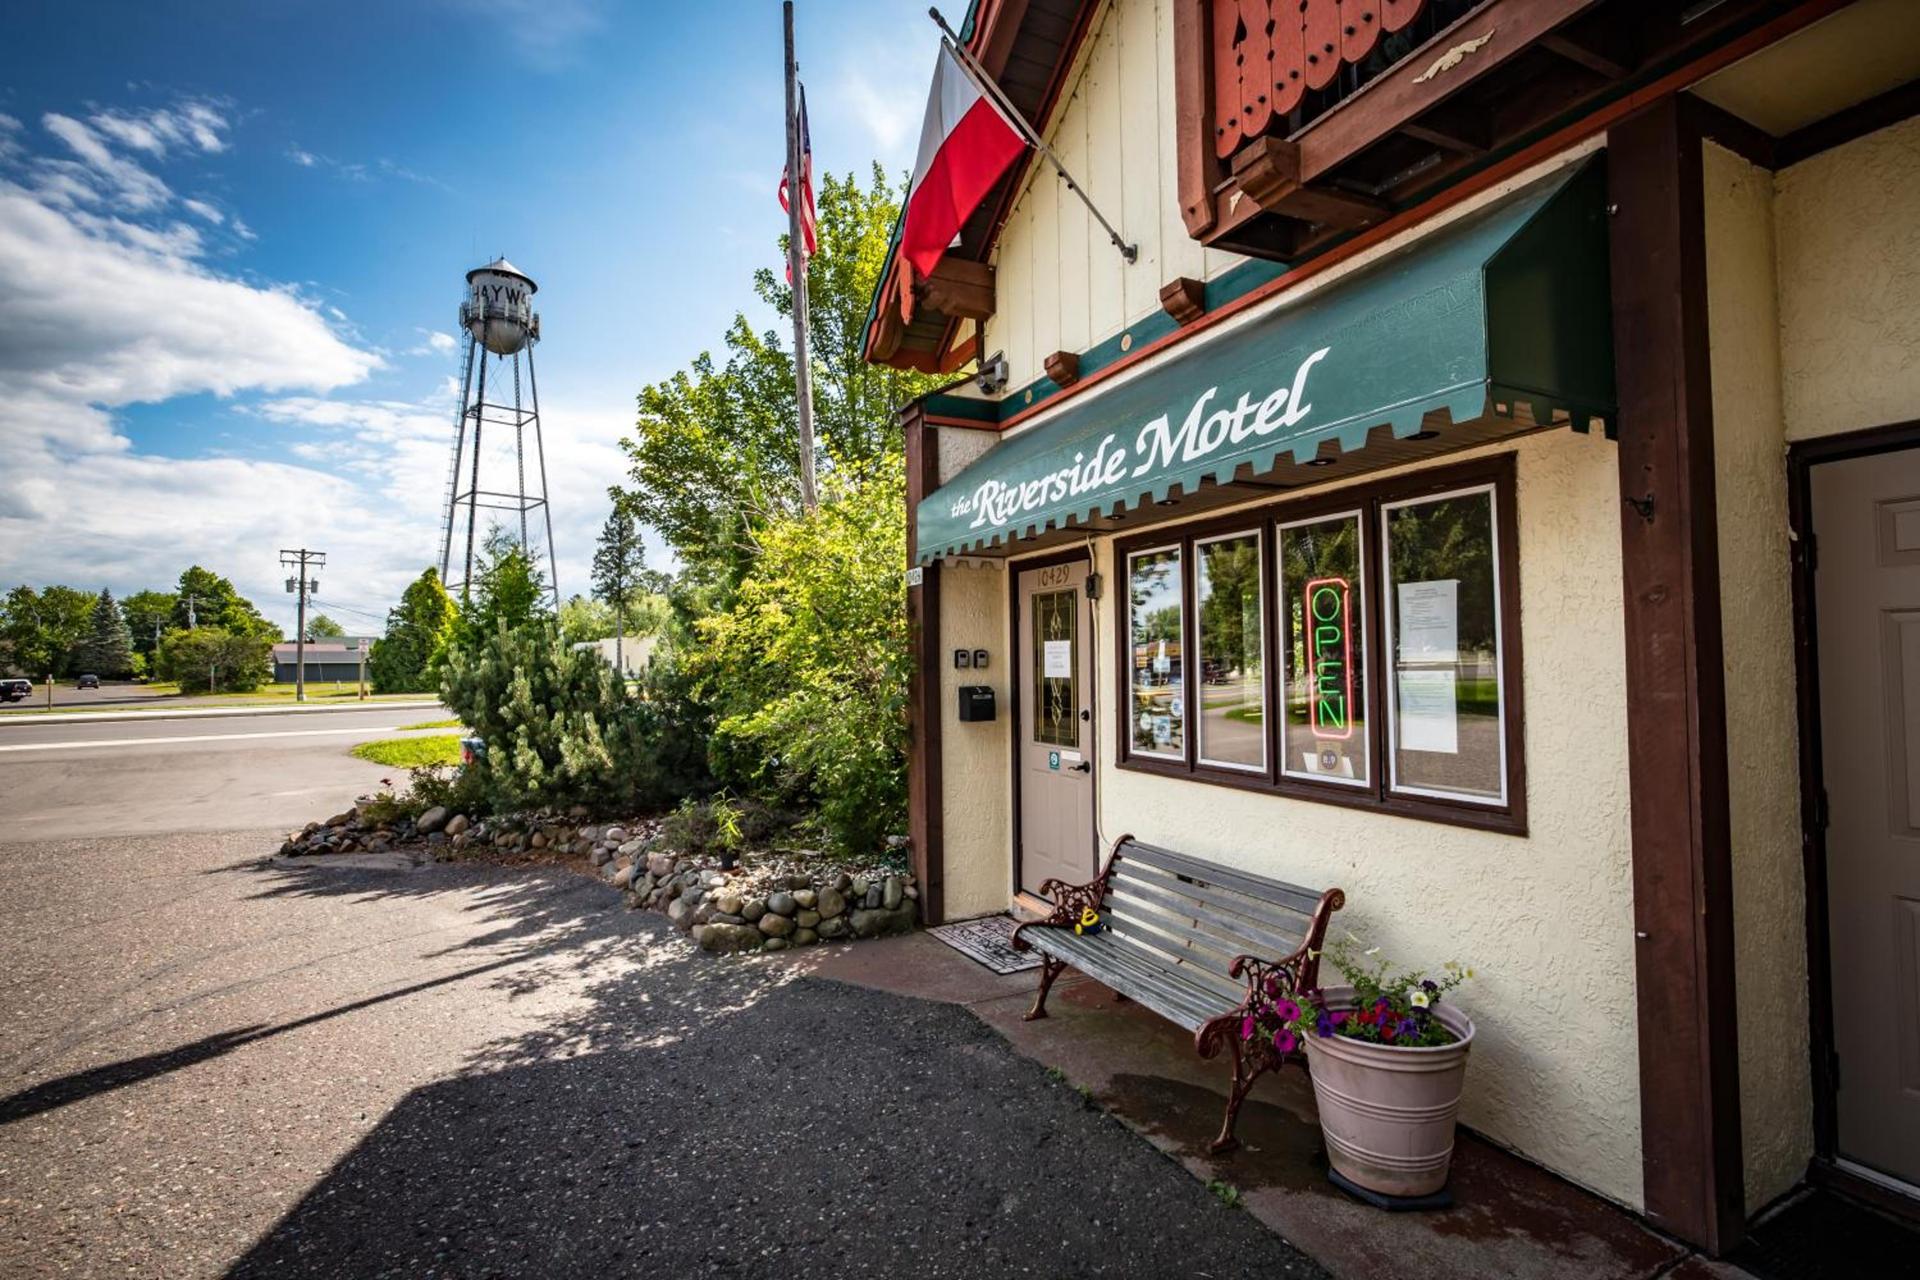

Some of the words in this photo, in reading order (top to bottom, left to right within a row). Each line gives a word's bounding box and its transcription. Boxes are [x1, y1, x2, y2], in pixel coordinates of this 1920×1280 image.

[951, 495, 972, 519] the
[970, 434, 1127, 528] Riverside
[1131, 346, 1330, 478] Motel
[1037, 564, 1070, 586] 10429
[1312, 587, 1344, 729] OPEN
